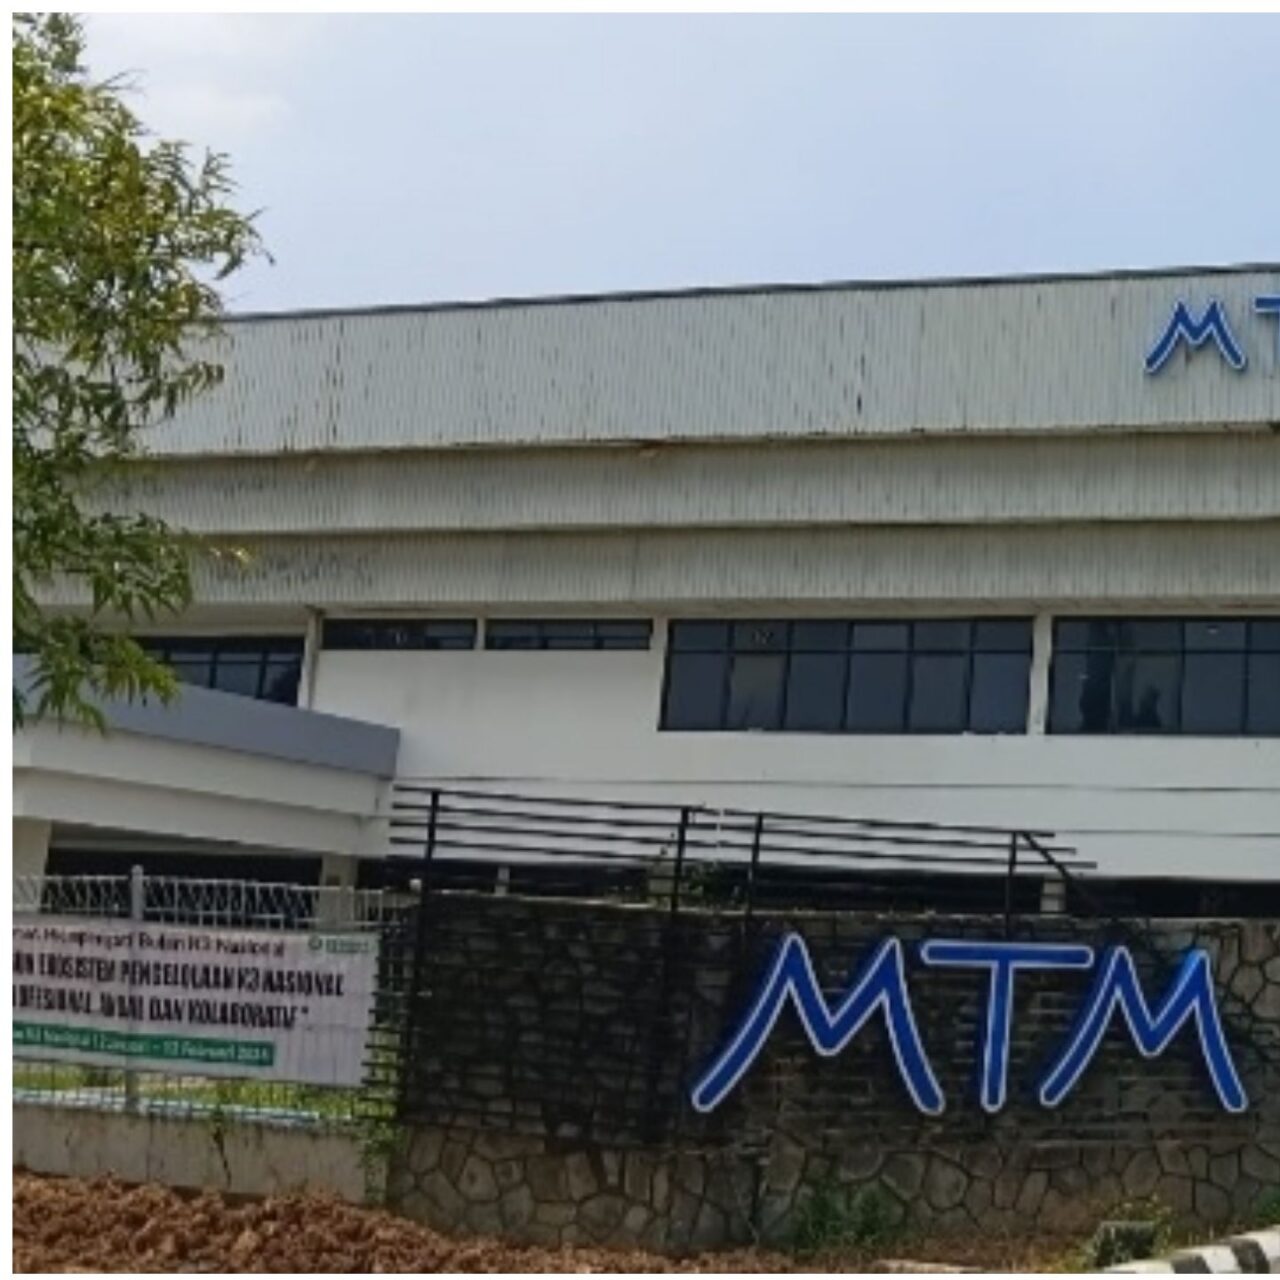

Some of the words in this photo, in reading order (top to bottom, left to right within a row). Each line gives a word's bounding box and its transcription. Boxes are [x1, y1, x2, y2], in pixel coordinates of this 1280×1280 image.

[237, 966, 260, 993] K3
[261, 969, 344, 997] NASIONAL
[148, 996, 184, 1022] DAN
[692, 932, 1247, 1115] MTM
